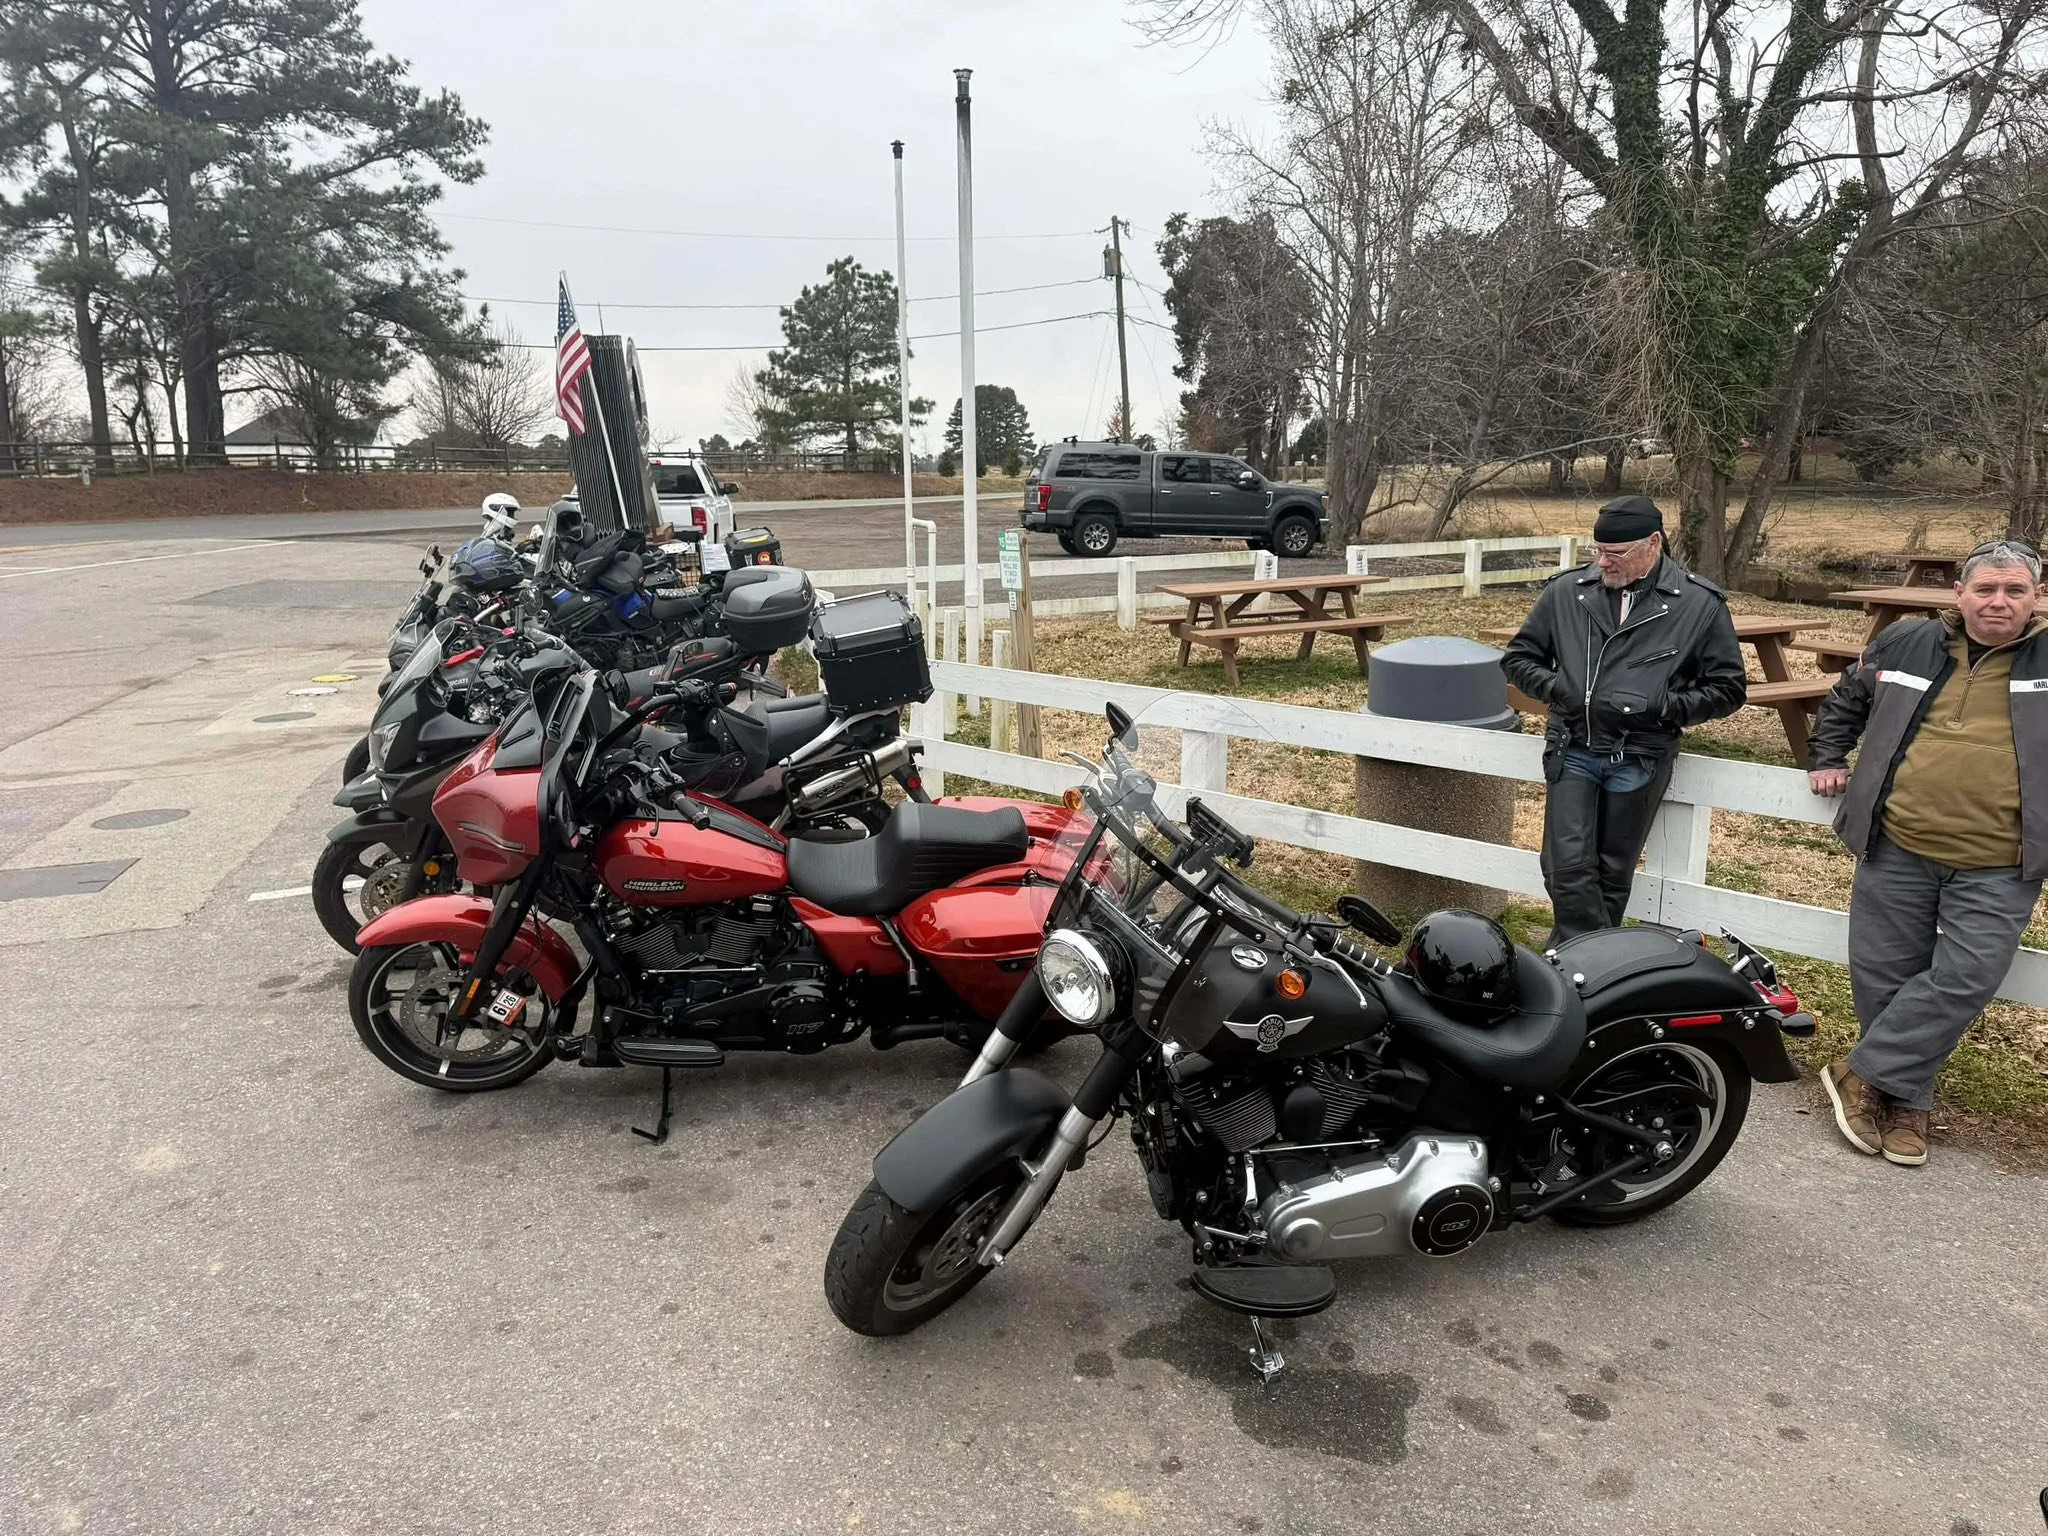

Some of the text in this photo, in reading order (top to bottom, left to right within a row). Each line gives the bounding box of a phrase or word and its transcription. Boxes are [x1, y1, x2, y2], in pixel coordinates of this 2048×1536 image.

[449, 677, 469, 686] UCATI
[623, 884, 685, 892] DAVIDSON
[503, 995, 517, 1007] 26
[1259, 1029, 1284, 1044] DAVIDSON
